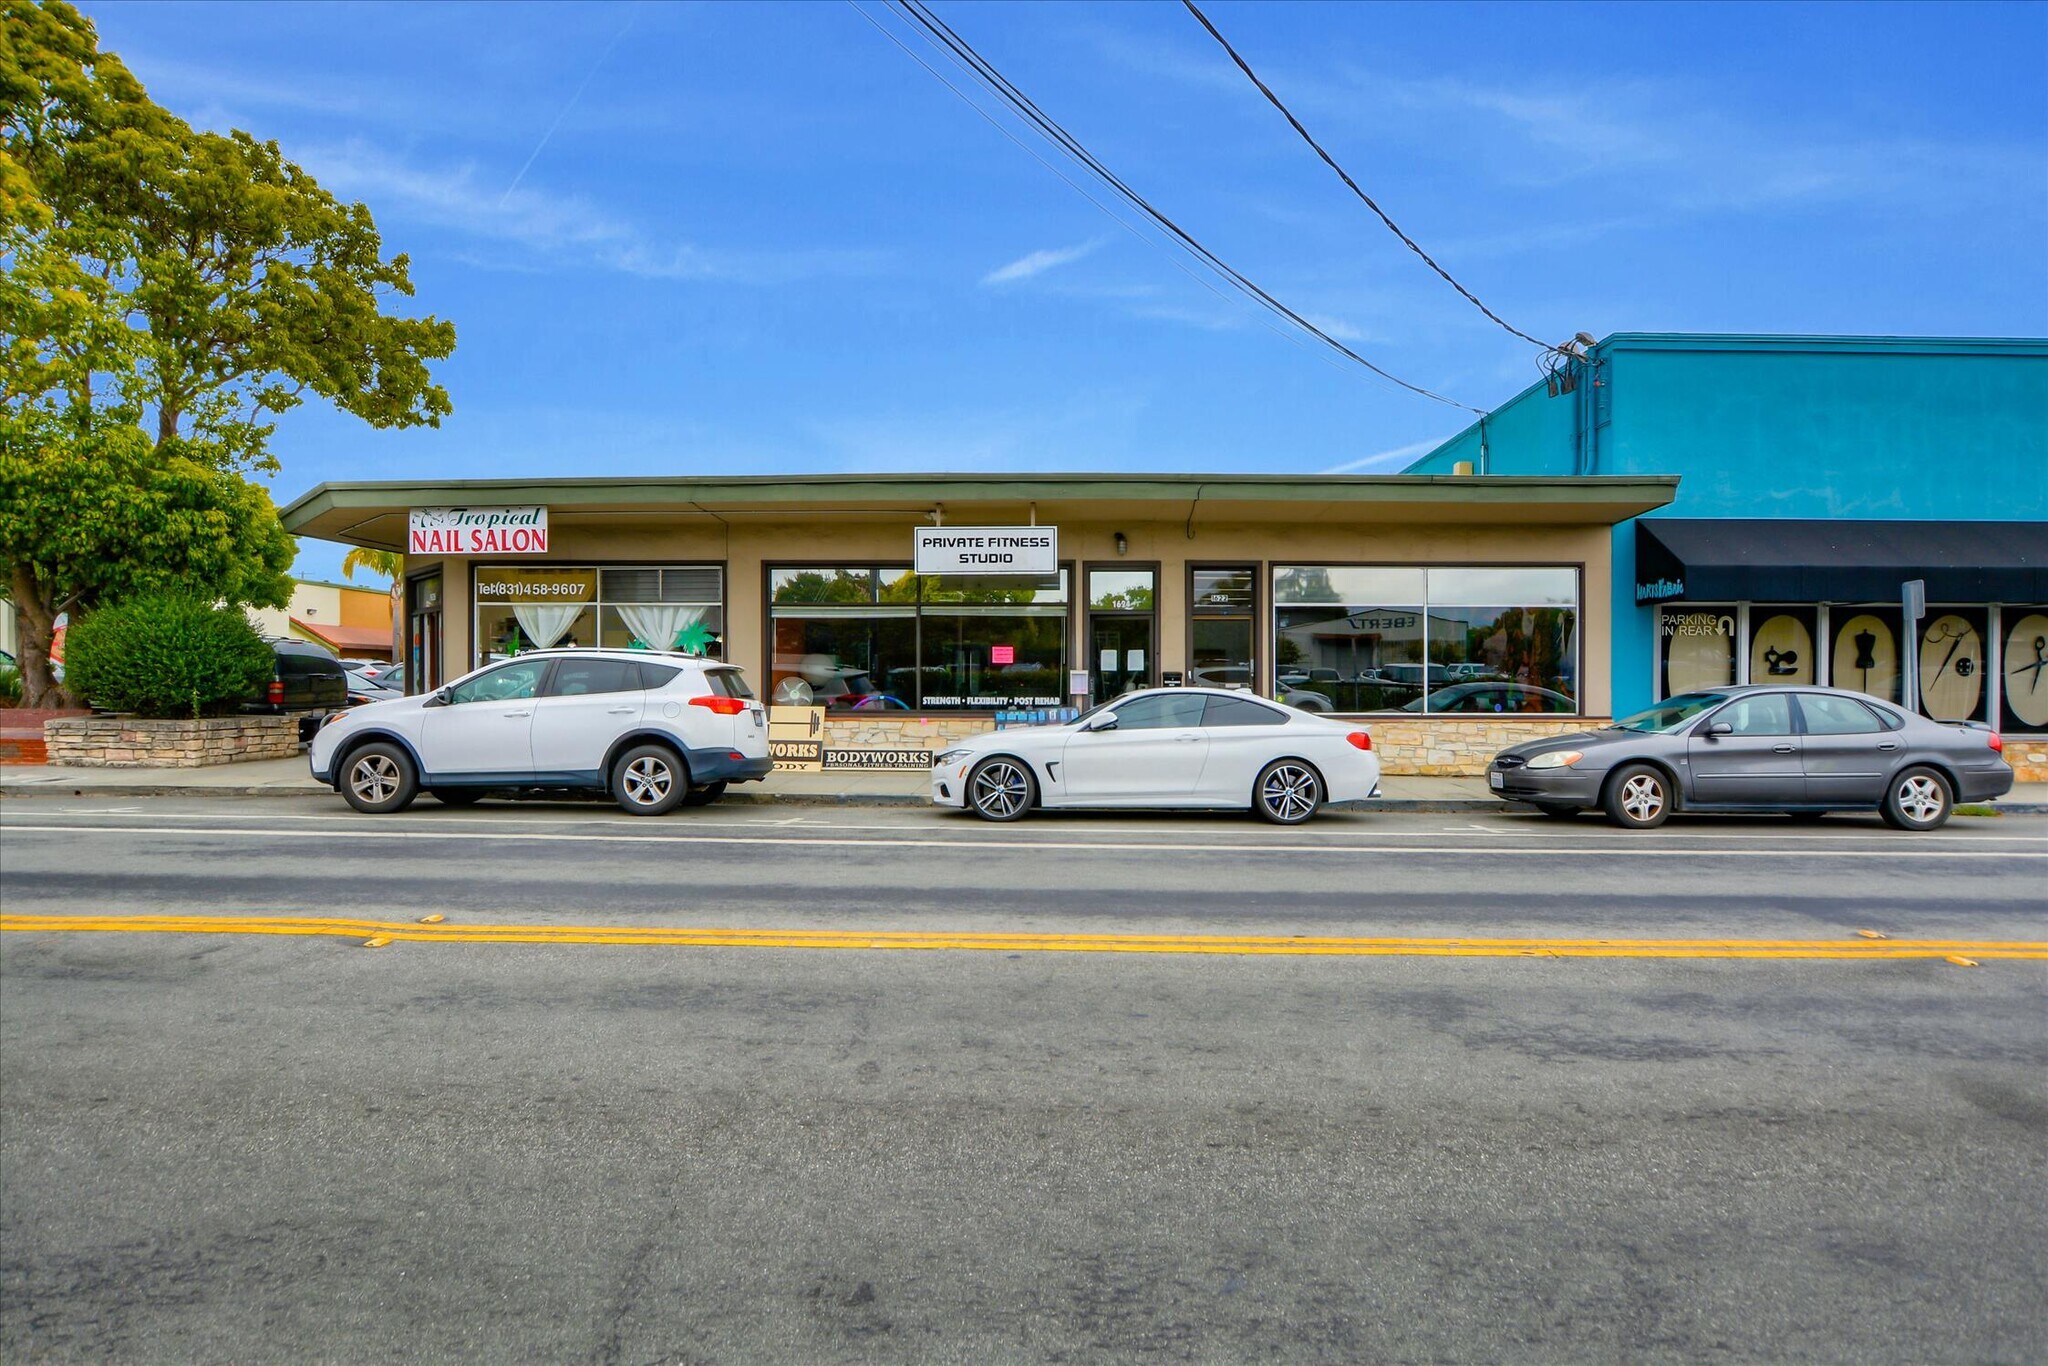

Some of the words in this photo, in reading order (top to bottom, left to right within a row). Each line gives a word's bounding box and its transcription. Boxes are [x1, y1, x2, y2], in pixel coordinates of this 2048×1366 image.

[447, 508, 541, 528] Tropical
[412, 530, 464, 552] NAIL
[471, 529, 546, 552] SALON
[922, 537, 984, 548] PRIVATE
[988, 537, 1050, 548] FITNESS
[959, 553, 1013, 564] STUDIO
[1661, 614, 1717, 626] PARKING
[1661, 626, 1674, 636] IN
[1680, 625, 1713, 636] REAR
[922, 697, 961, 705] STRENGTH
[967, 697, 1008, 705] FLEXIBILITY
[1014, 697, 1034, 705] POST
[1035, 697, 1061, 705] REHAB
[826, 751, 930, 763] BODYWORKS
